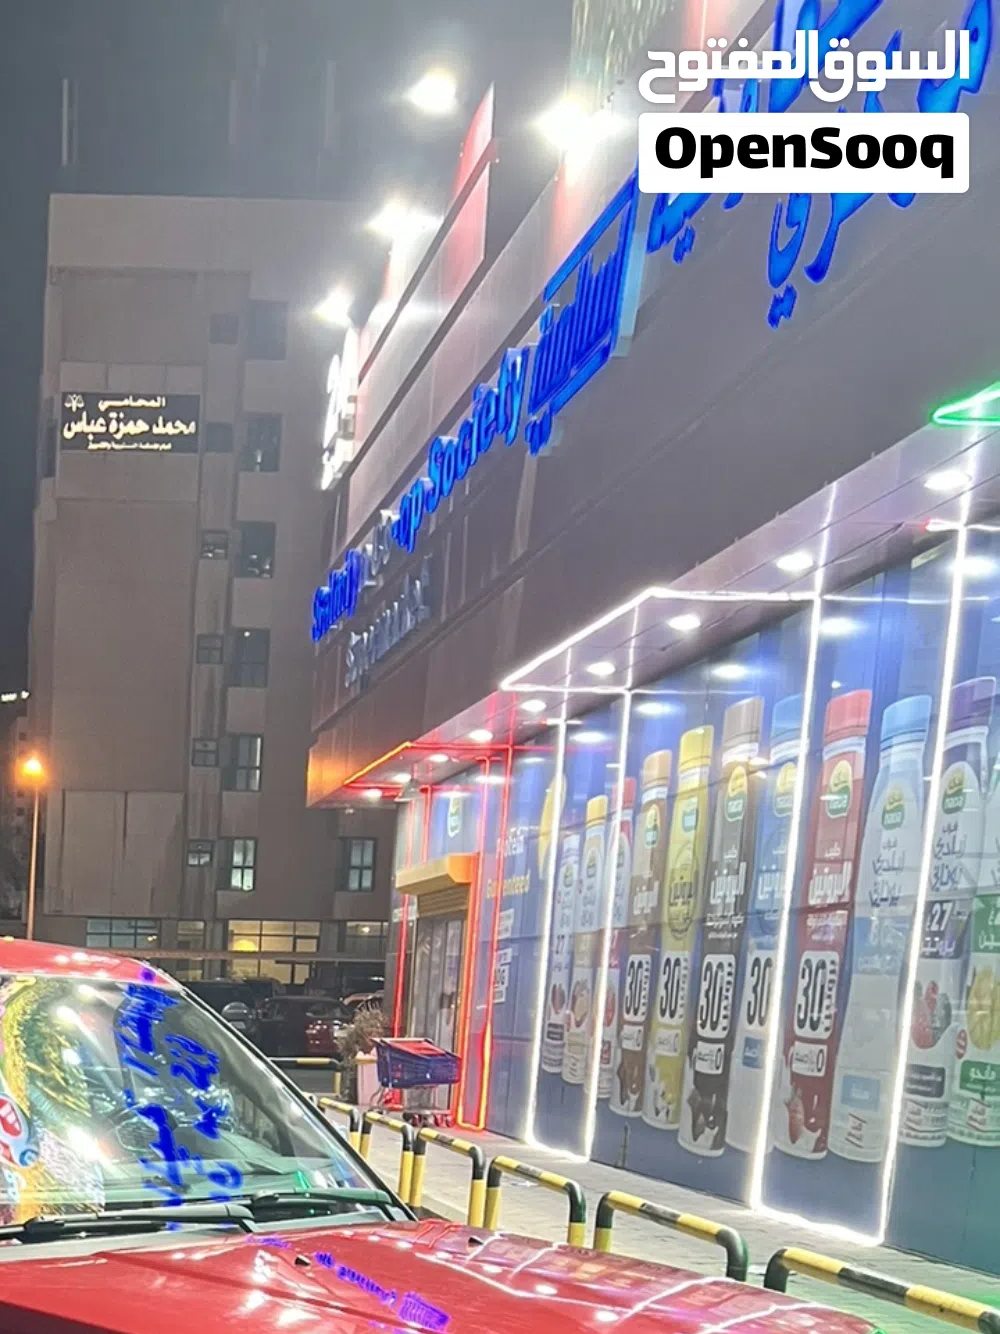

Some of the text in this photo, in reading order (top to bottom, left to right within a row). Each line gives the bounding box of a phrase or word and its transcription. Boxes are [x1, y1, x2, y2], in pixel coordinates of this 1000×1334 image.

[63, 410, 197, 442] محمد حمزة عباس
[625, 959, 644, 1017] 30
[659, 957, 681, 1020] 30
[699, 960, 725, 1032] 30
[747, 956, 773, 1027] 30
[796, 957, 827, 1032] 30
